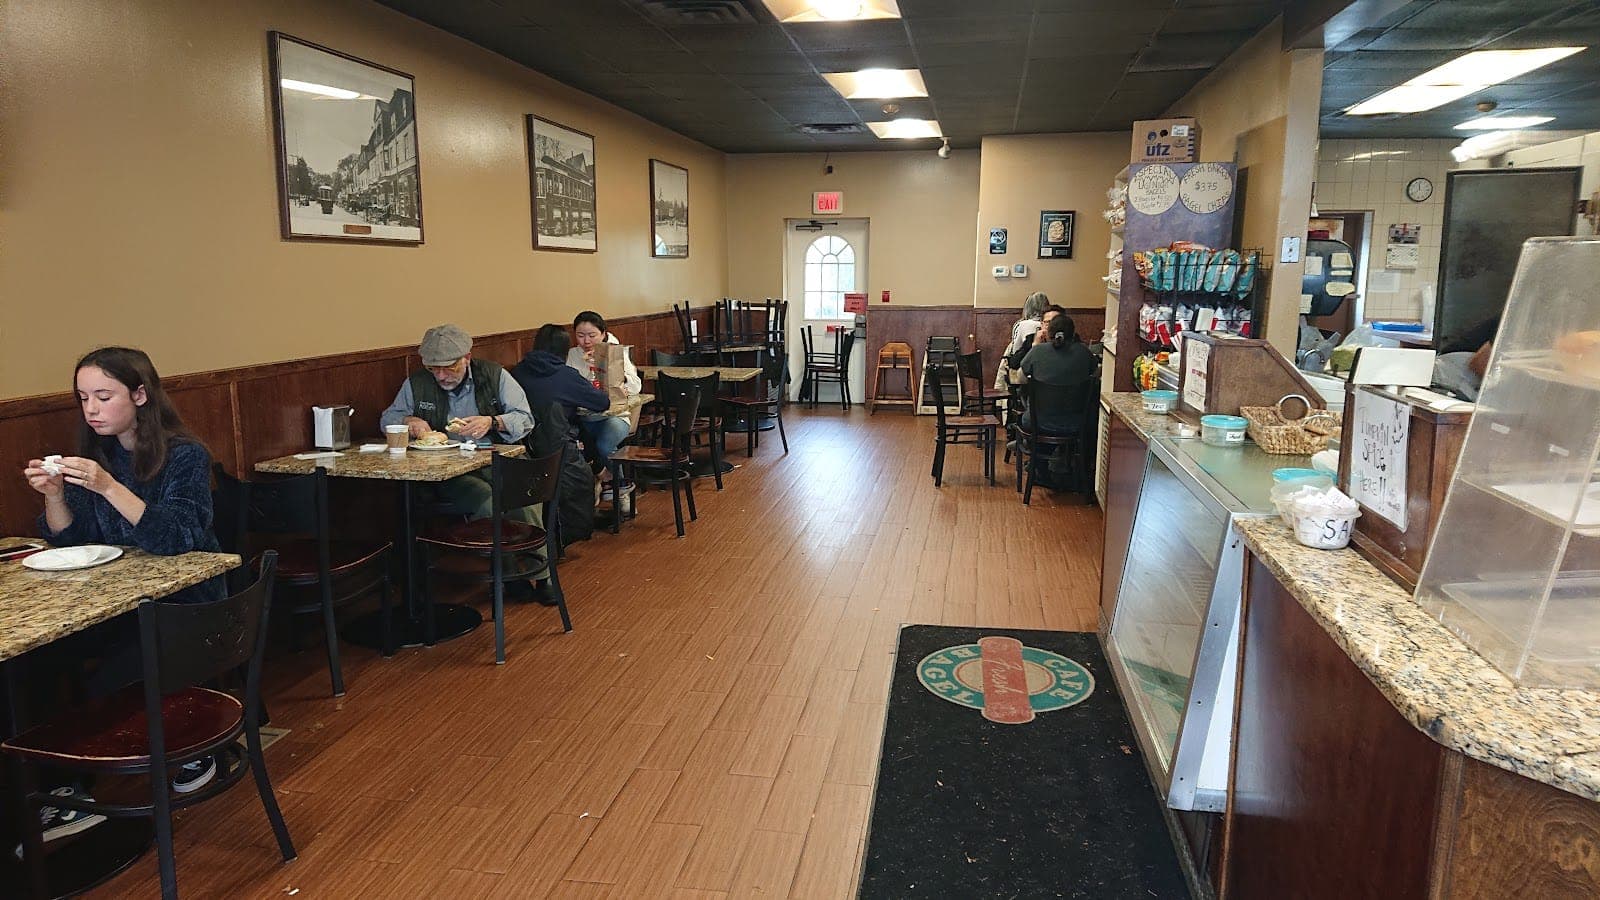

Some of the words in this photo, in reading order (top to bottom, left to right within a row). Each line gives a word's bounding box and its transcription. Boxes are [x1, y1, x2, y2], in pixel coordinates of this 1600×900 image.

[1146, 143, 1171, 156] utz
[818, 199, 838, 211] EXIT
[1323, 518, 1355, 540] SA
[924, 646, 976, 703] BAGEL
[1040, 658, 1085, 700] CAFE
